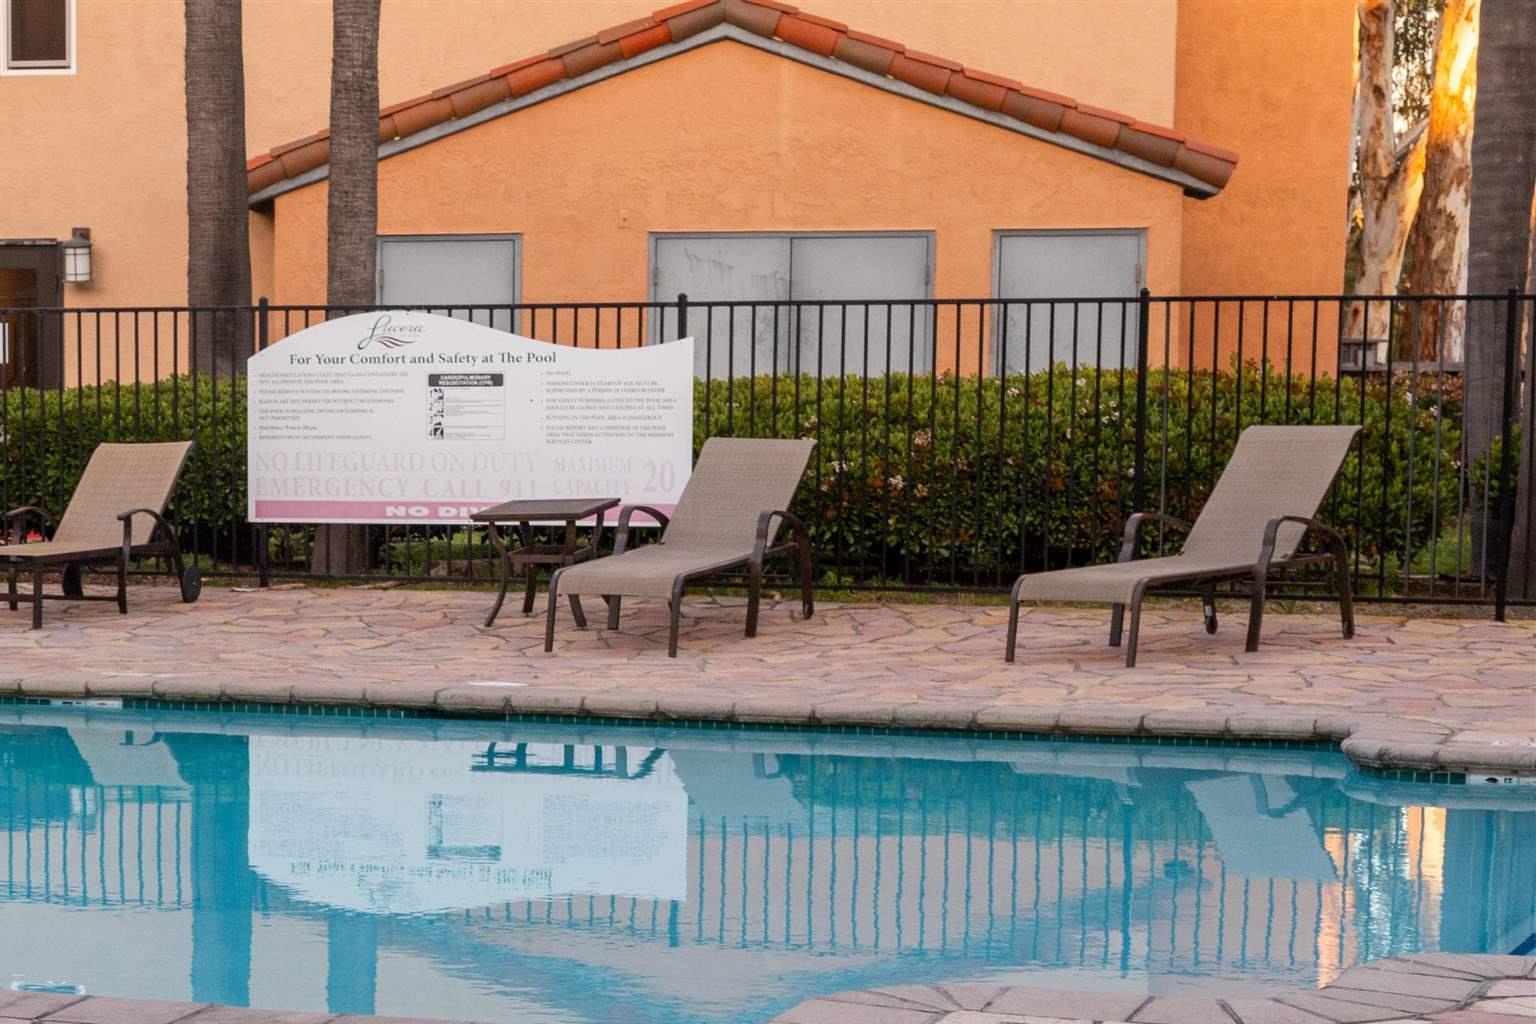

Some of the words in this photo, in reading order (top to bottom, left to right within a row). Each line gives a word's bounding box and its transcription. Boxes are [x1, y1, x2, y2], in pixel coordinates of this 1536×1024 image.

[289, 355, 313, 366] For
[316, 354, 345, 365] Your
[349, 353, 406, 365] Comfort
[410, 353, 435, 365] and
[438, 352, 478, 367] Safety
[481, 354, 494, 364] at
[497, 352, 523, 364] The
[527, 352, 557, 364] Pool
[255, 452, 289, 473] NO
[295, 452, 425, 473] LIFEGUARD
[431, 452, 466, 473] ON
[472, 451, 538, 473] DUTY
[553, 456, 632, 473] MAXIMUM
[642, 461, 675, 494] 20
[255, 477, 409, 498] EMERGENCY
[423, 478, 489, 498] CALL
[499, 478, 537, 498] 911
[553, 479, 632, 496] CAPACITY
[385, 506, 430, 517] NO
